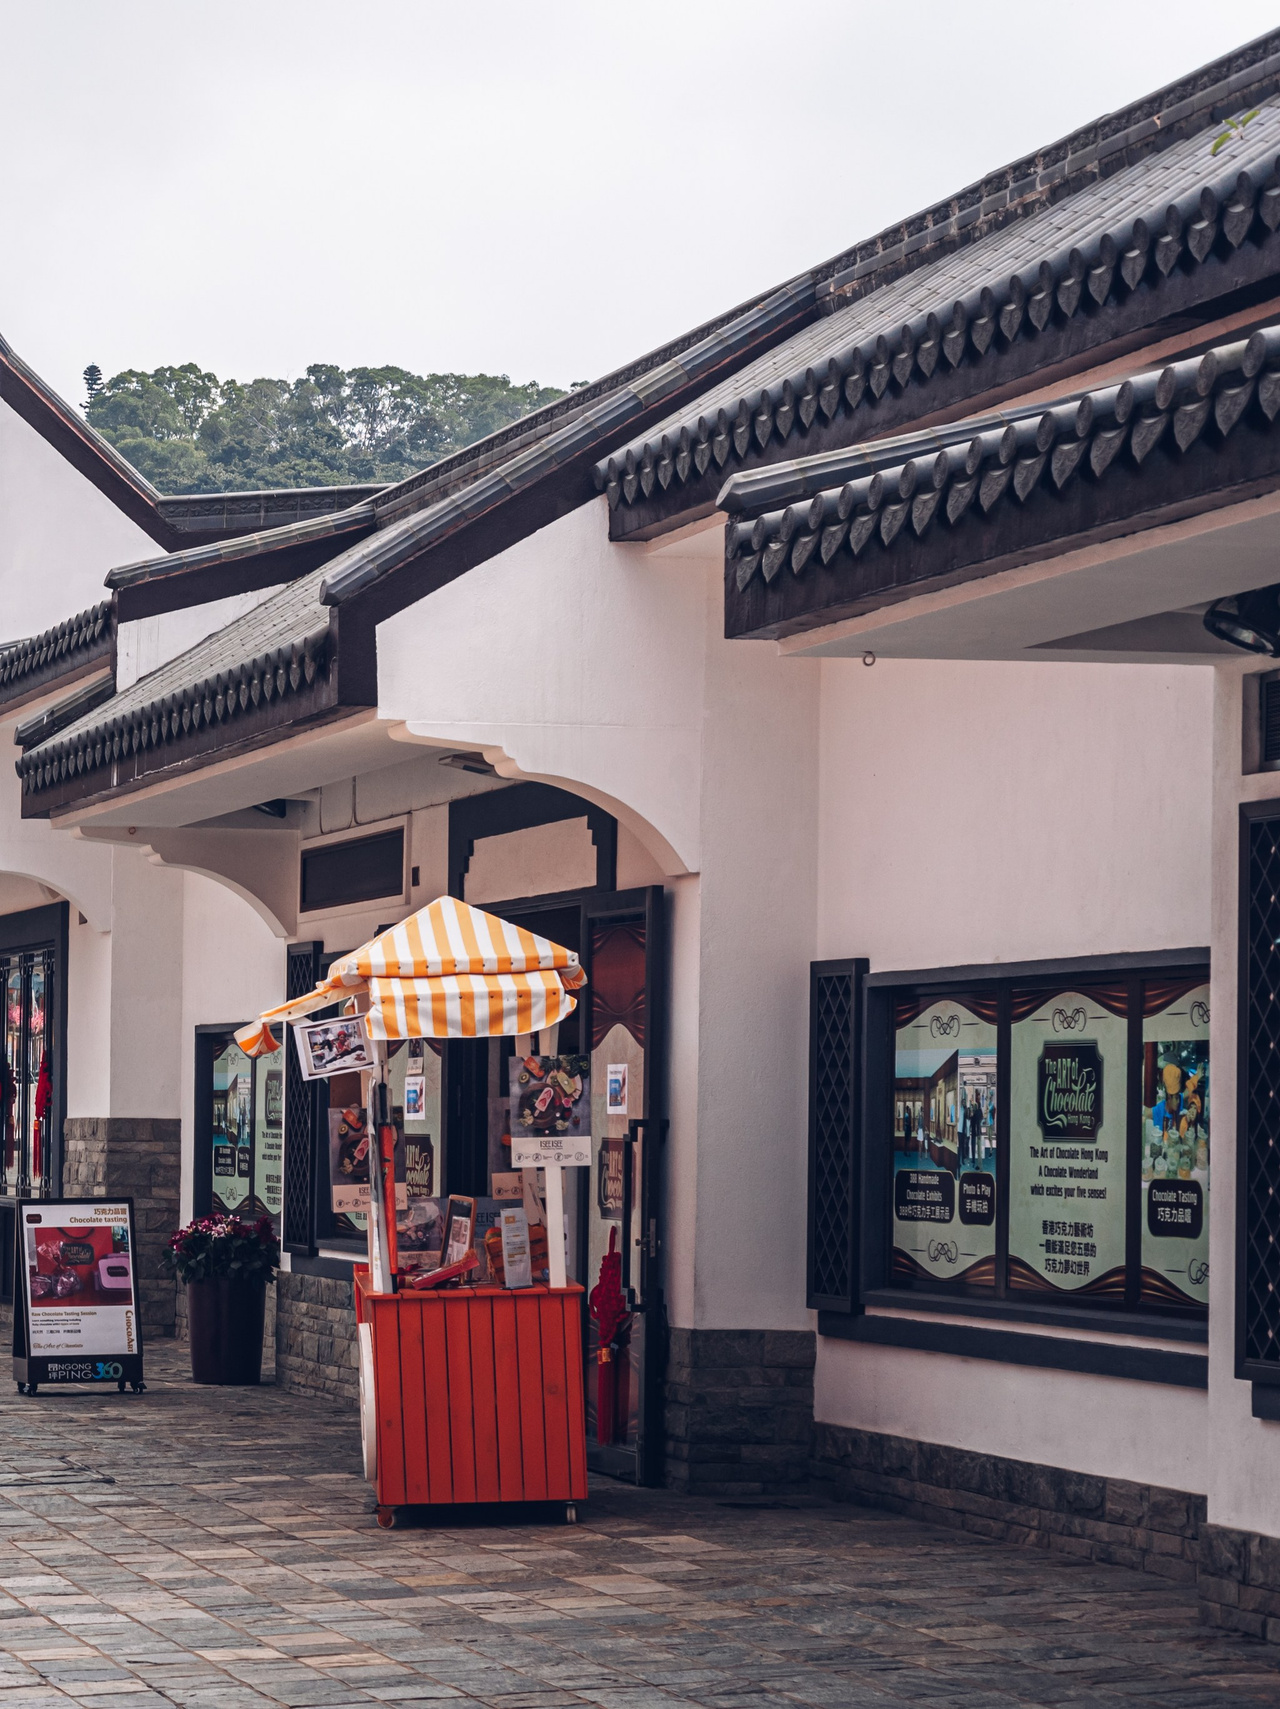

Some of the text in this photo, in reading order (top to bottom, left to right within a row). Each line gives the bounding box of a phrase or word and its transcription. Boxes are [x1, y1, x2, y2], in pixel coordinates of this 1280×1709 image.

[1045, 1057, 1079, 1089] The ART of
[1044, 1068, 1096, 1122] Chocolate
[1030, 1146, 1109, 1163] The Art of Chocolate Hong Kong
[1038, 1165, 1099, 1180] A Chocolate Wonderland
[906, 1189, 943, 1202] Chocolate Exhibits
[962, 1183, 976, 1195] Photo
[981, 1184, 992, 1198] Play
[1030, 1184, 1107, 1200] which excites your five senses!
[1152, 1190, 1198, 1206] Chocolate Tasting
[69, 1216, 128, 1224] Chocolate tasting
[1042, 1220, 1094, 1239] 香港巧克力藝術坊
[1044, 1258, 1090, 1277] 巧克力夢幻世界
[58, 1361, 123, 1379] PING 360
